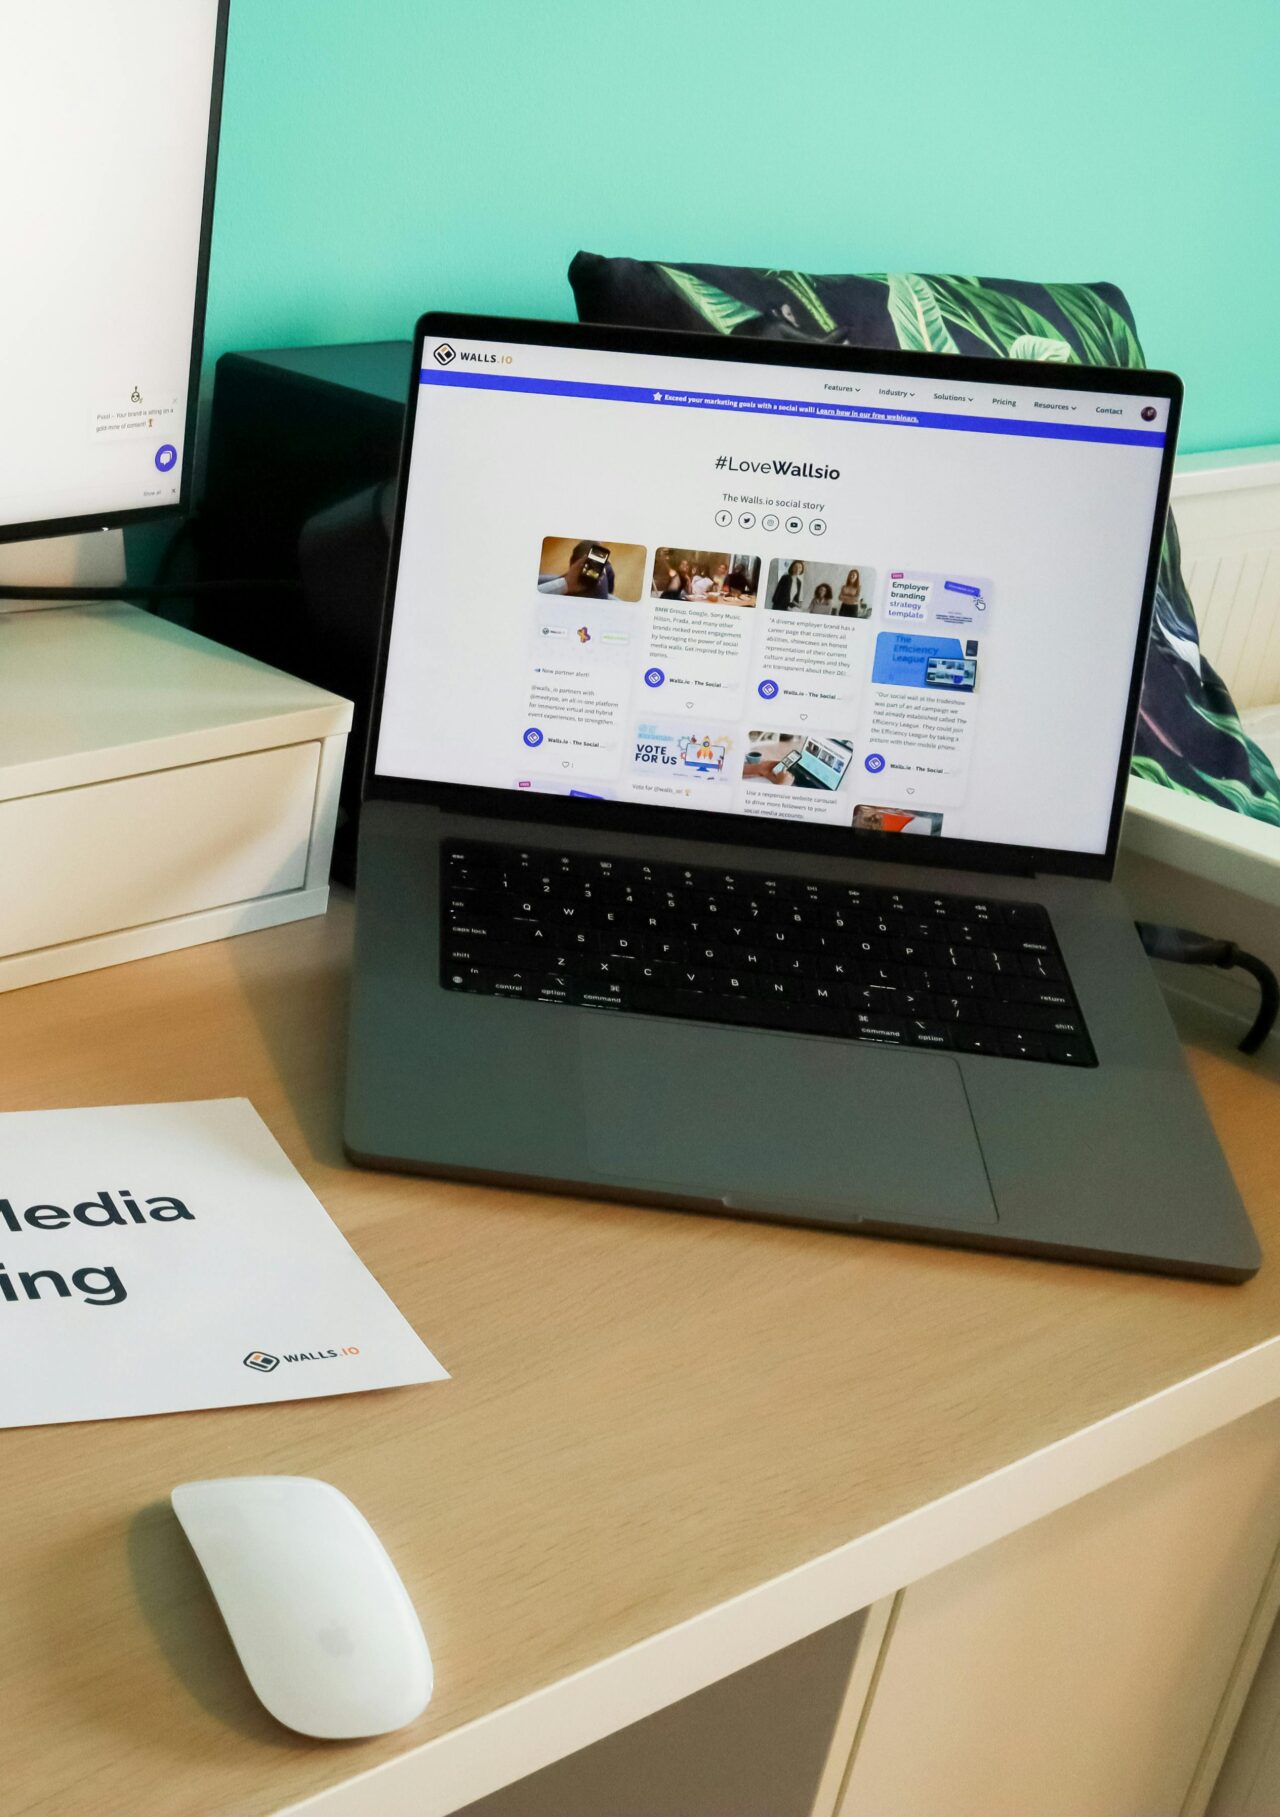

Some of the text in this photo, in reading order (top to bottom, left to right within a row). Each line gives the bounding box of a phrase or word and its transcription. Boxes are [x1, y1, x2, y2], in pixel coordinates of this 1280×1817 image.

[460, 352, 513, 364] WALLS.IO
[824, 383, 853, 392] Features
[879, 388, 908, 398] Industry
[933, 393, 966, 402] Solutions
[664, 394, 687, 402] Exceed
[688, 396, 703, 404] your
[704, 398, 738, 408] marketing
[738, 401, 756, 409] goals
[816, 407, 836, 415] Learn
[872, 411, 885, 419] free
[992, 398, 1017, 407] Pricing
[1034, 401, 1069, 411] Resources
[1095, 406, 1123, 415] Contact
[715, 455, 840, 480] #LoveWallsio
[722, 493, 825, 512] The Walls.io social story
[892, 581, 929, 592] Employer
[890, 591, 926, 602] branding
[889, 601, 921, 610] strategy
[888, 610, 924, 619] template
[896, 635, 912, 643] The
[893, 644, 939, 656] Efficiency
[892, 655, 925, 664] League
[636, 743, 667, 755] VOTE
[635, 752, 677, 765] FOR US
[495, 983, 522, 991] control
[541, 988, 566, 998] option
[583, 993, 621, 1003] command
[283, 1345, 360, 1366] WALLS.IO
